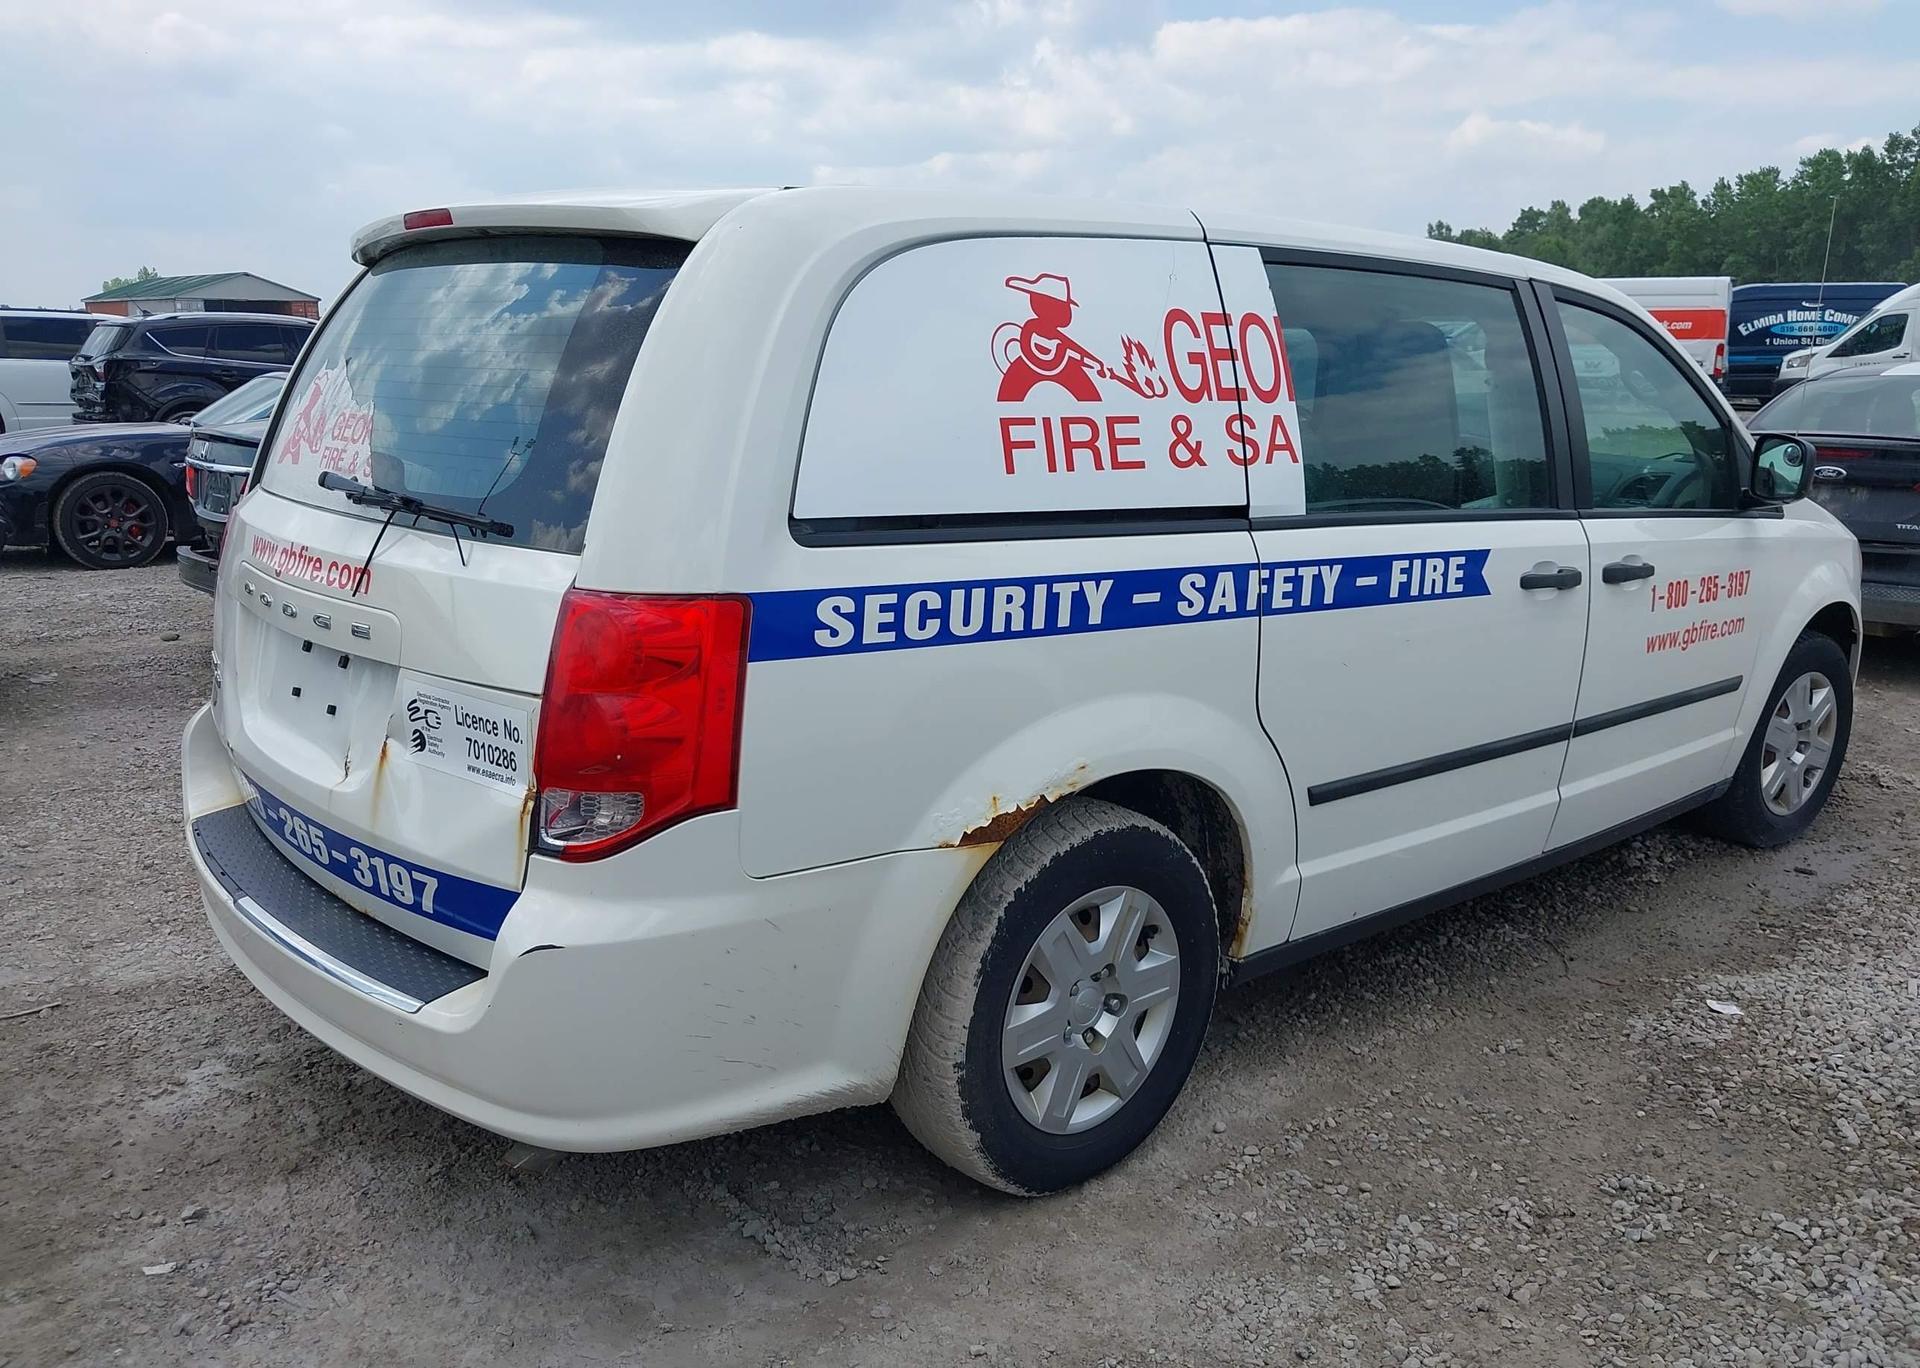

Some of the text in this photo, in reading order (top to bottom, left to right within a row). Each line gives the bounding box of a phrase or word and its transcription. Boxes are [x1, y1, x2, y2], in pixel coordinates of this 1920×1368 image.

[1738, 313, 1785, 337] ELMIRA
[1787, 309, 1822, 322] HOME
[1773, 338, 1799, 346] Union
[320, 446, 347, 472] FIRE
[348, 450, 359, 474] &
[999, 413, 1299, 475] FIRE & SA
[1895, 523, 1920, 531] TITA
[252, 534, 373, 595] www.gbfire.com
[244, 579, 372, 640] DODGE
[813, 578, 1115, 649] SECURITY
[1176, 564, 1343, 617] SAFETY
[1389, 556, 1467, 599] FIRE
[1645, 616, 1746, 654] www.gbfire.com
[454, 704, 523, 745] Licence No.
[465, 737, 517, 772] 7010286
[466, 763, 516, 786] www.esaecra.info
